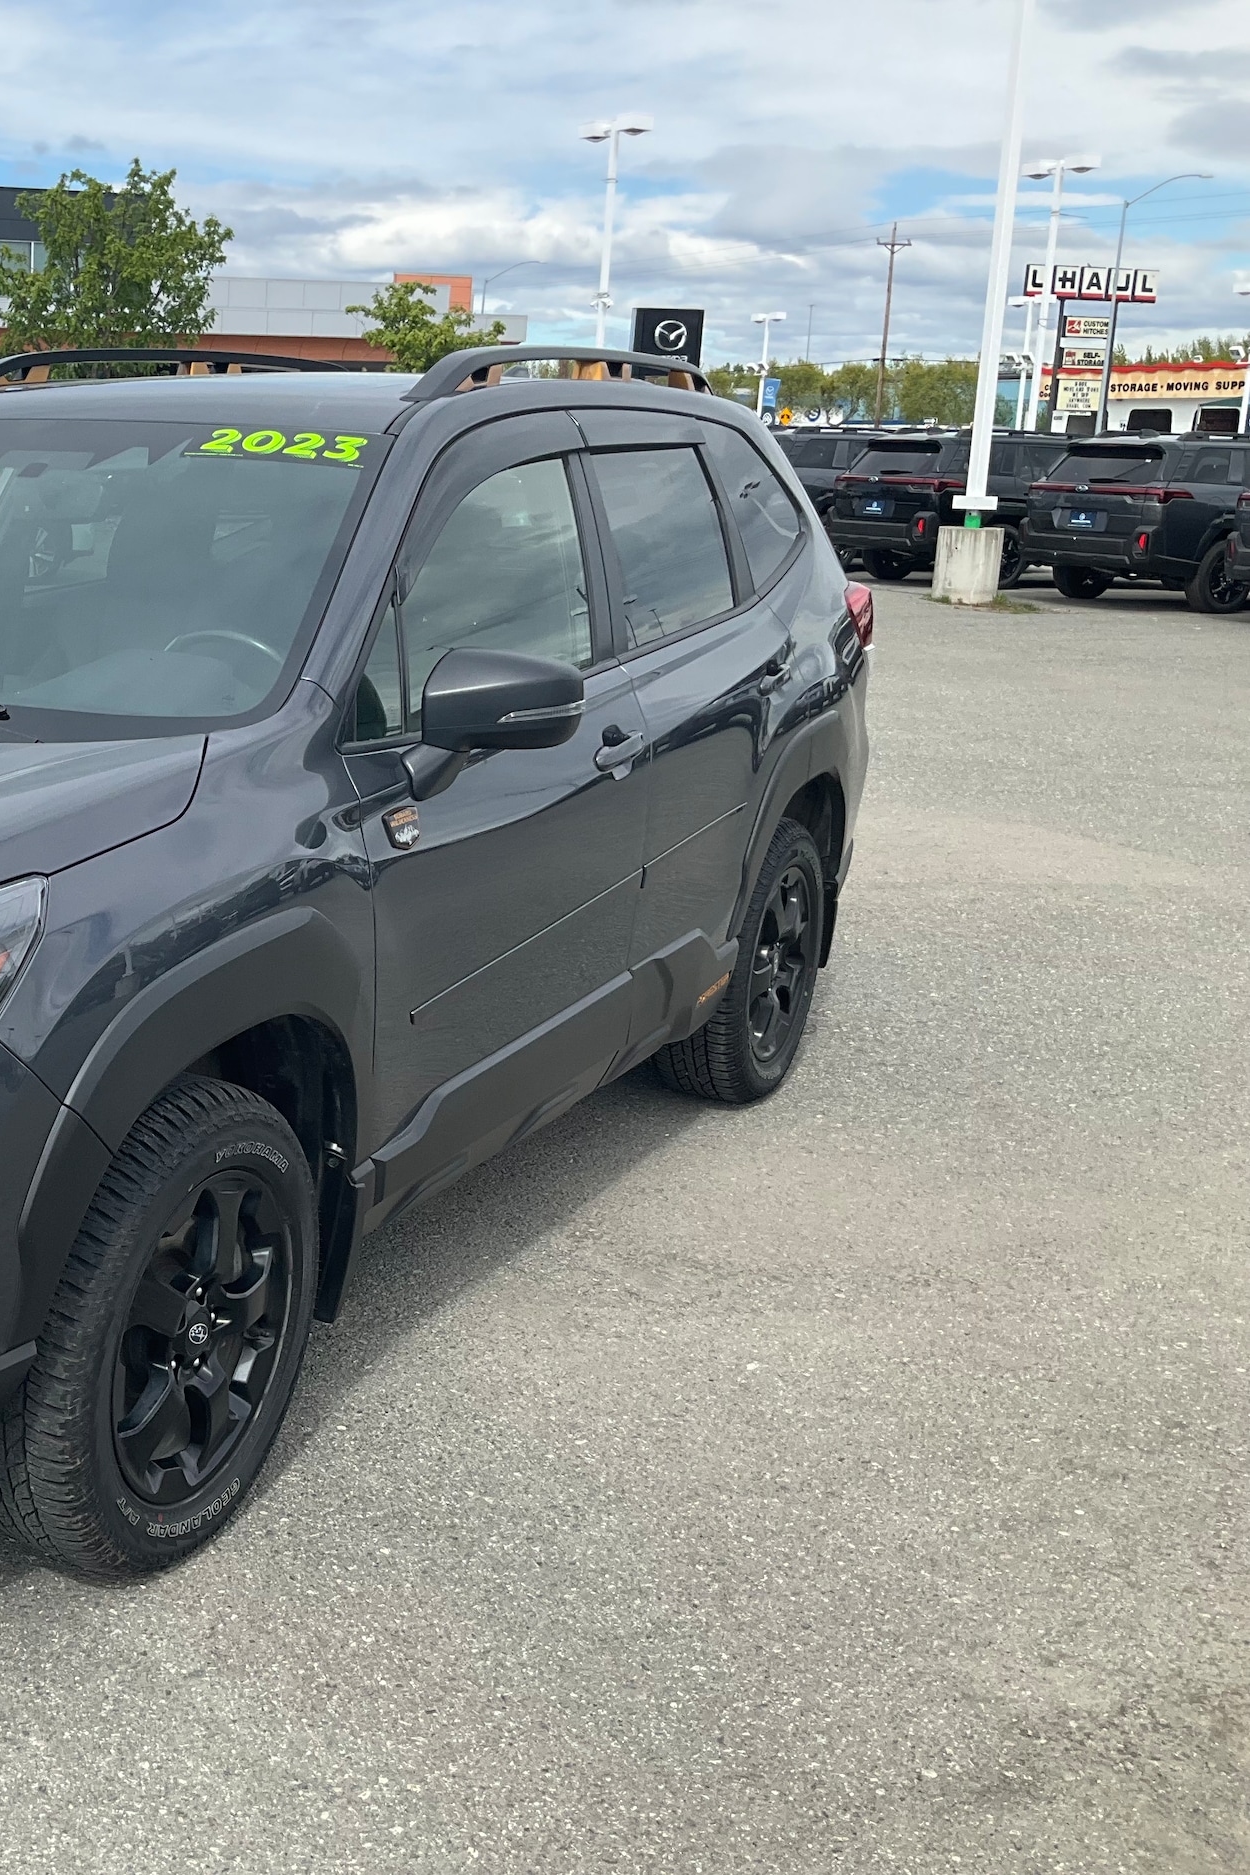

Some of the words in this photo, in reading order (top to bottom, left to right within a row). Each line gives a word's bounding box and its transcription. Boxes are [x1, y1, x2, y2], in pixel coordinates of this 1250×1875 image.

[1083, 320, 1109, 328] CUSTOM
[1110, 383, 1158, 392] STORAGE
[1166, 381, 1209, 392] MOVING
[200, 429, 368, 462] 2023
[215, 1141, 289, 1173] YOKOHAMA
[116, 1498, 140, 1525] A/T
[147, 1477, 240, 1537] GEOLANDAR
